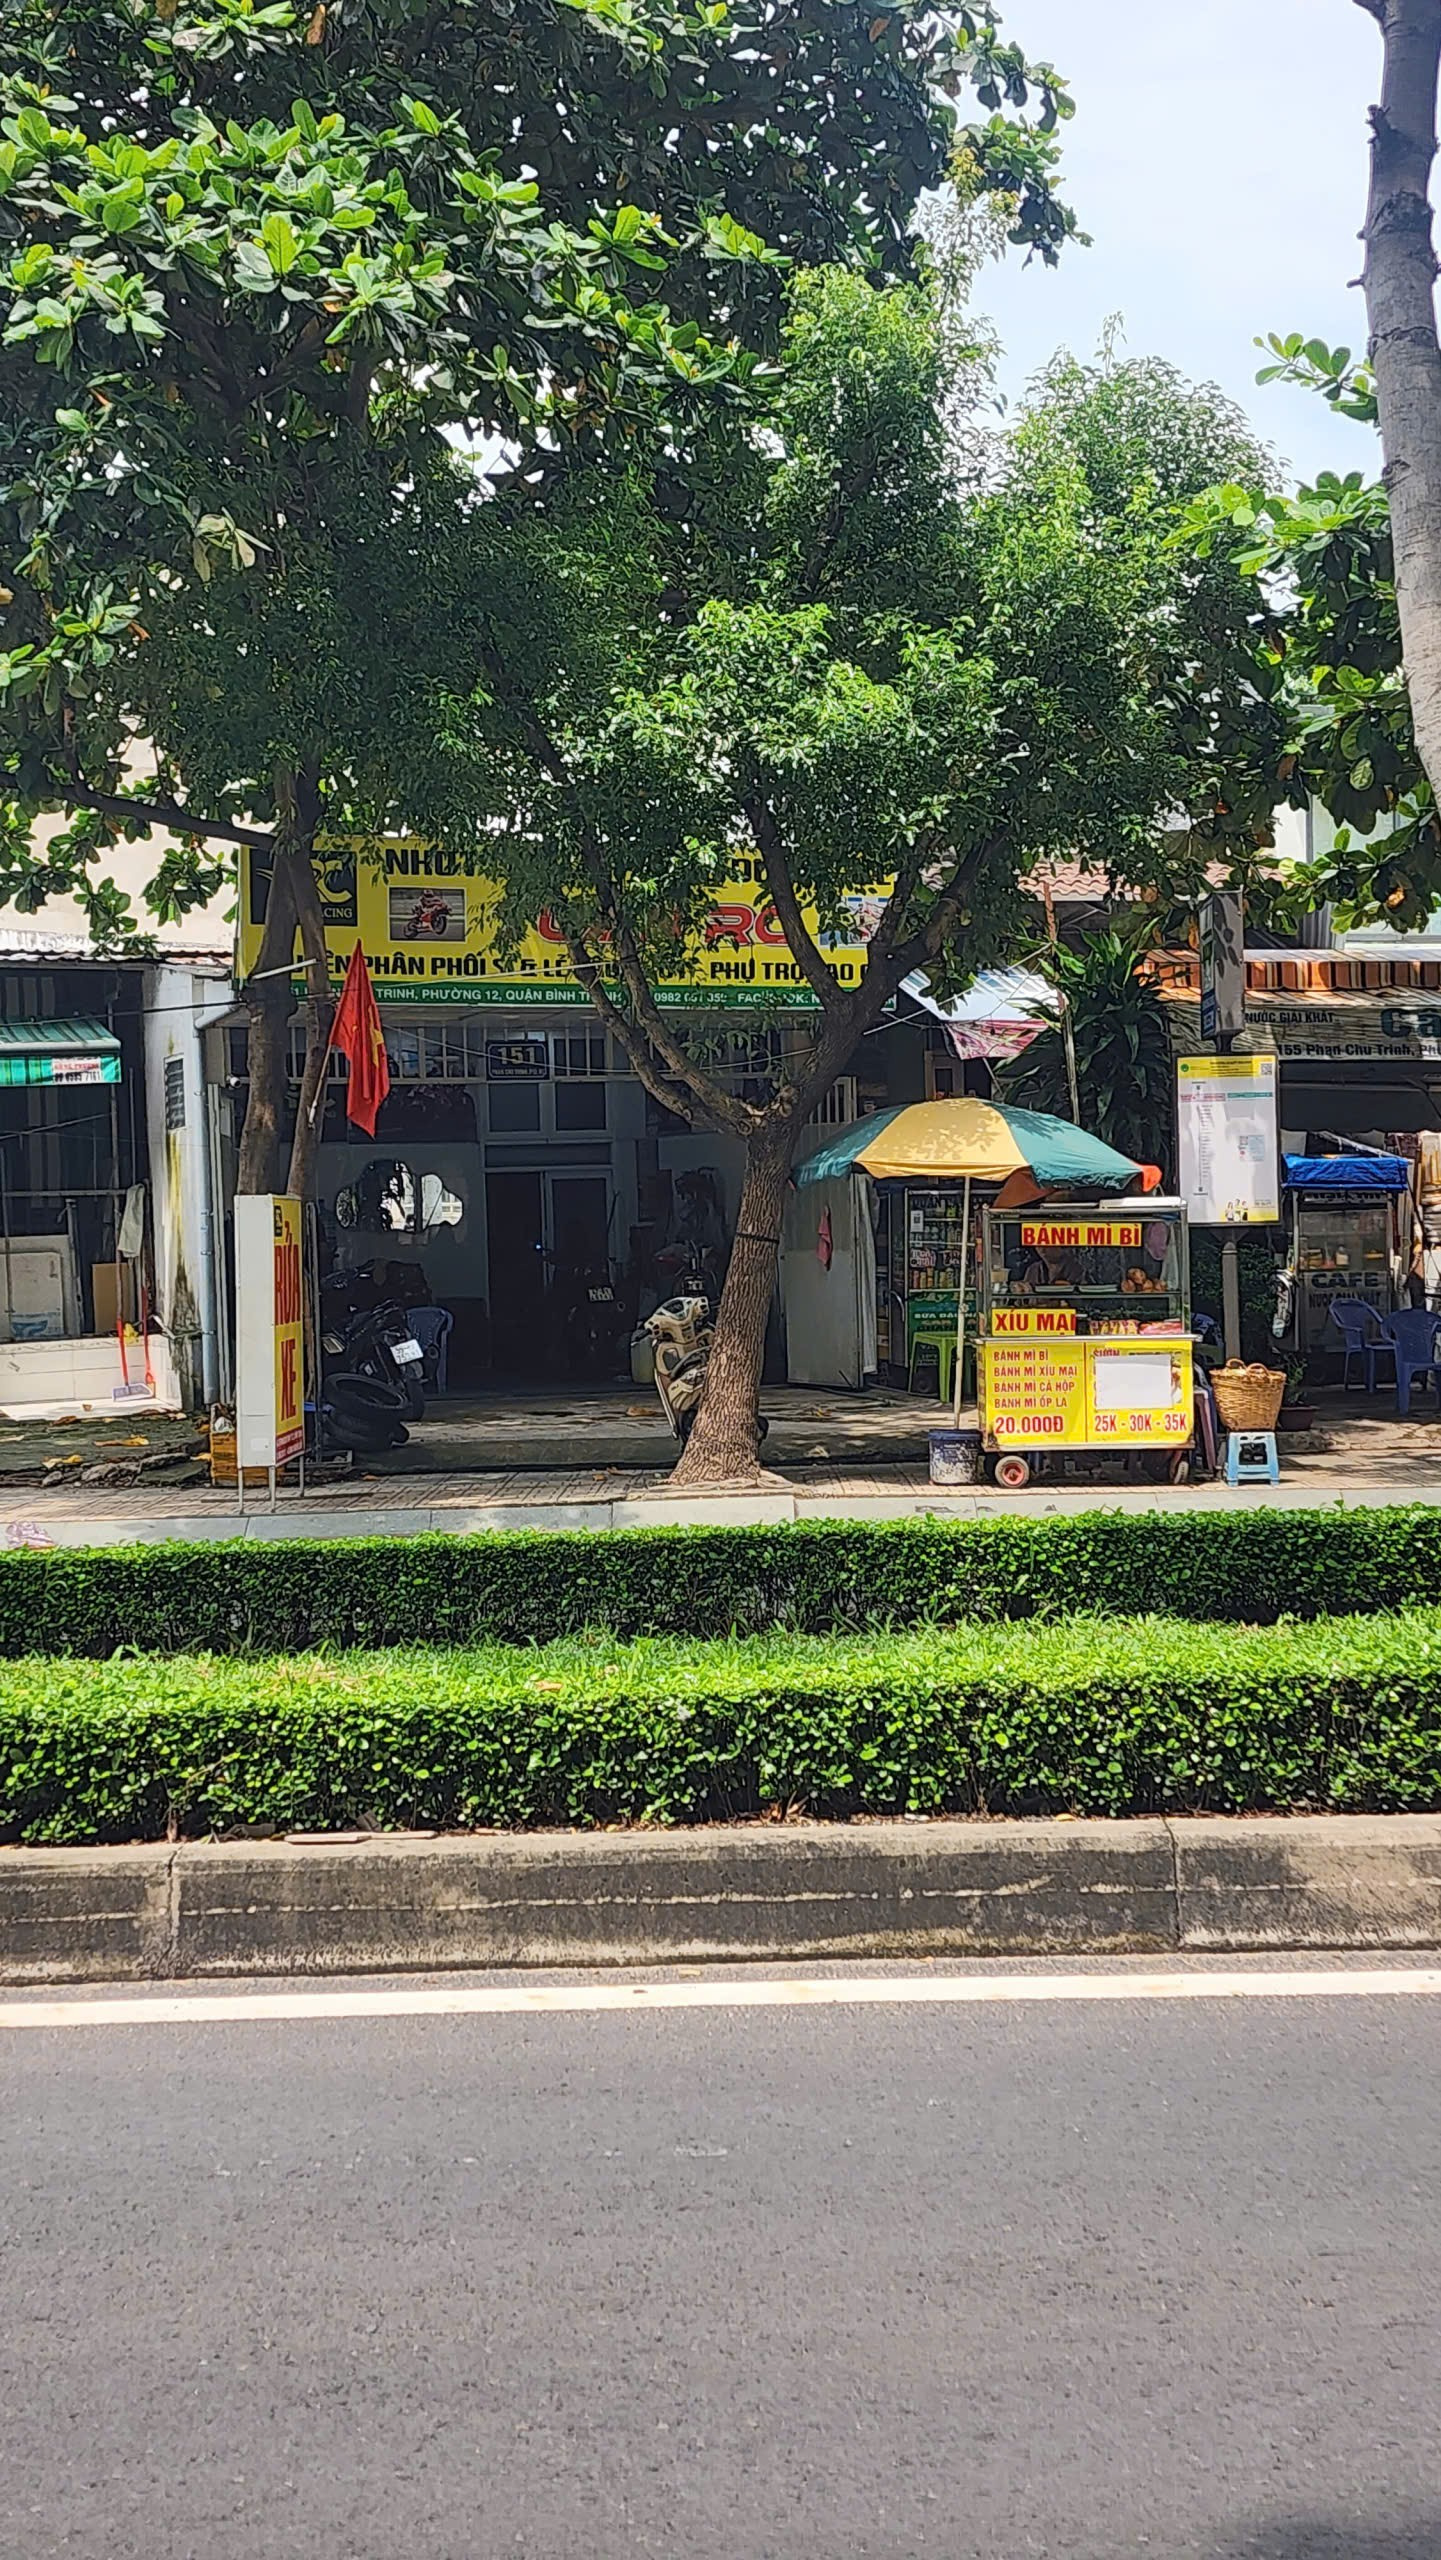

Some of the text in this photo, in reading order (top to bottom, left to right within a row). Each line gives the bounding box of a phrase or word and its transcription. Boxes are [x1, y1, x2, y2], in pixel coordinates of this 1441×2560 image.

[365, 951, 424, 976] PHÂN
[710, 961, 756, 983] PHỤ
[376, 988, 418, 1000] TRINH,
[422, 987, 482, 1000] PHƯỜNG
[486, 990, 502, 1001] 12,
[506, 989, 543, 1002] QUẬN
[545, 988, 576, 1001] BÌNH
[654, 992, 681, 1002] 0982
[498, 1047, 535, 1065] 151
[1278, 1045, 1301, 1056] 155
[1345, 1044, 1372, 1056] Chu
[1023, 1222, 1140, 1246] BÁNH MÌ BÌ
[1311, 1272, 1379, 1289] CAFE
[995, 1308, 1029, 1332] XÍU
[1036, 1313, 1076, 1335] MẠI
[993, 1349, 1049, 1362] BÁNH MÌ BÌ
[993, 1365, 1022, 1377] BÁNH
[1024, 1364, 1036, 1376] MÌ
[1039, 1364, 1056, 1377] XÍU
[280, 1338, 297, 1422] XE
[993, 1381, 1021, 1393] BÁNH
[1024, 1380, 1036, 1392] MÌ
[994, 1397, 1021, 1409] BÁNH
[1024, 1396, 1037, 1408] MÌ
[995, 1415, 1064, 1434] 20.000Đ
[1094, 1414, 1117, 1432] 25K
[1129, 1414, 1153, 1432] 30K
[1164, 1413, 1188, 1431] 35K
